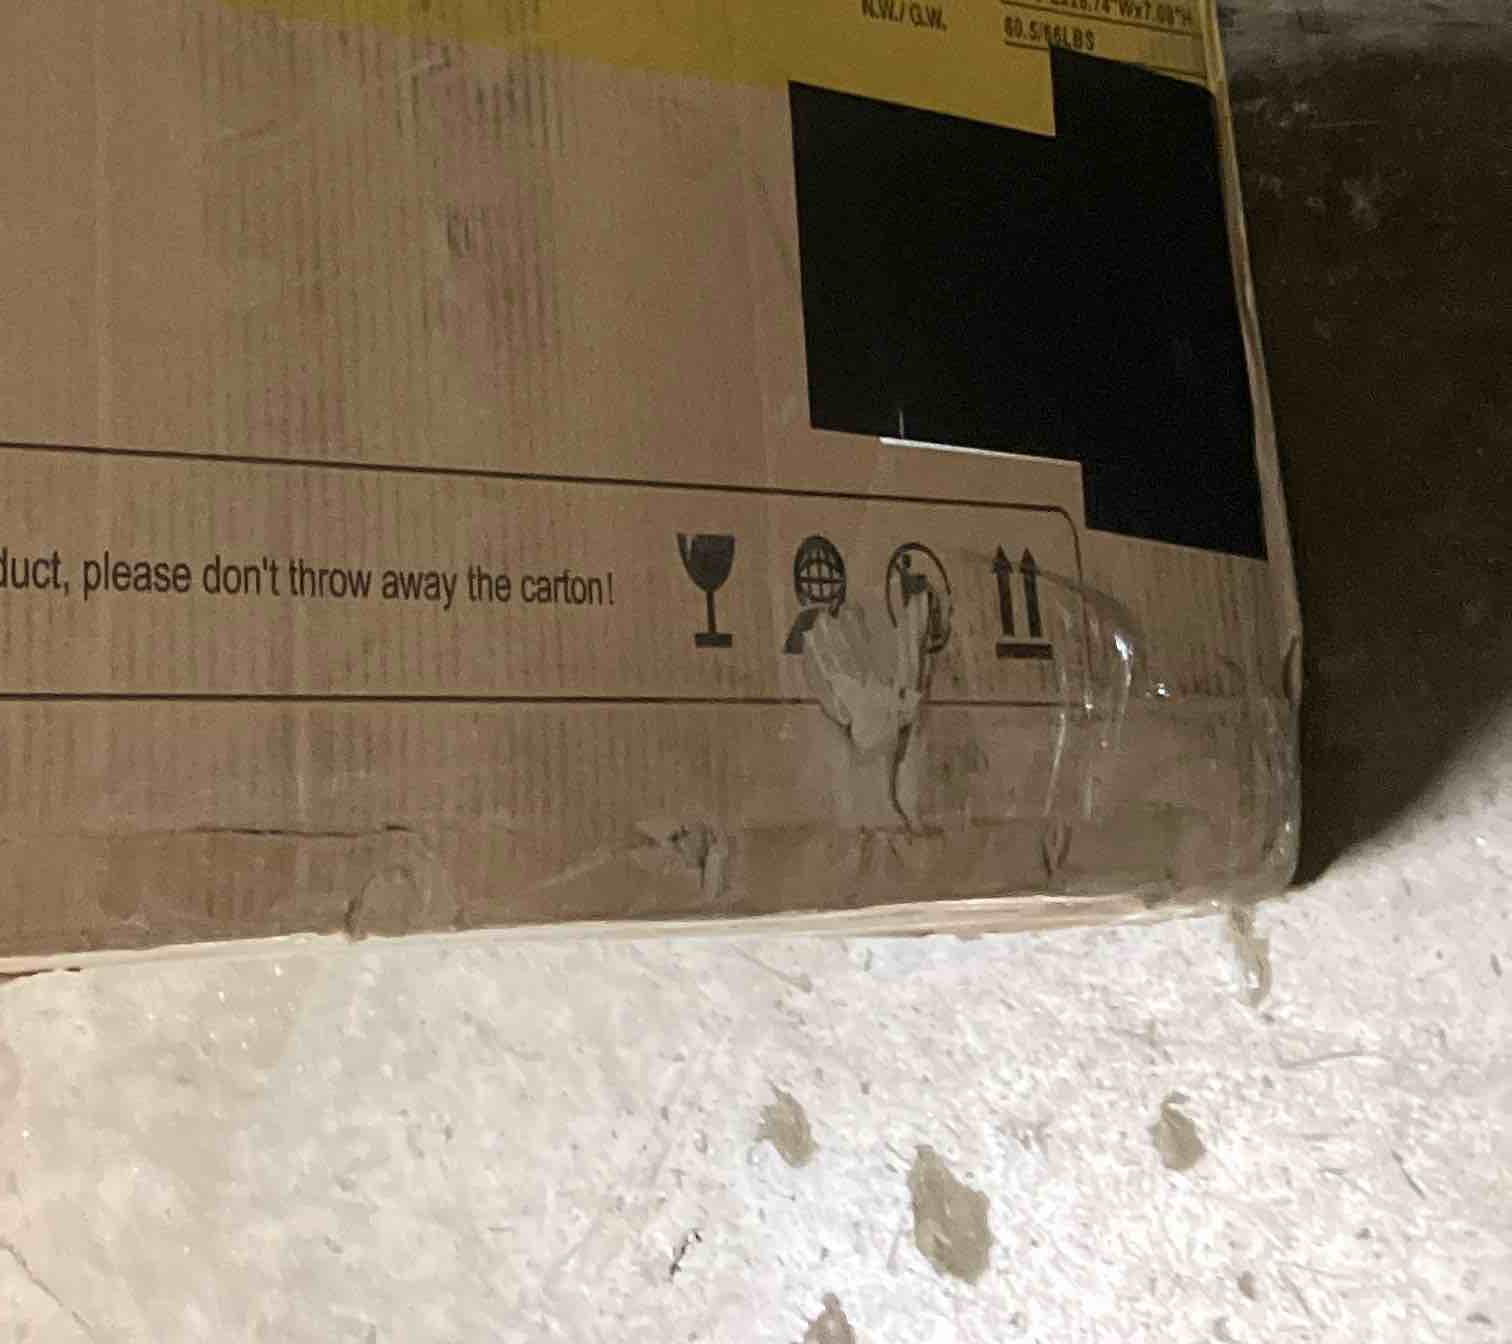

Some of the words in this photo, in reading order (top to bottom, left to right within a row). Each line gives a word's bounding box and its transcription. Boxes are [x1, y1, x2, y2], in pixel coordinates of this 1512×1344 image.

[82, 551, 192, 601] please
[202, 555, 280, 598] don't
[288, 556, 372, 600] throw
[381, 567, 456, 610] away
[467, 564, 512, 605] the
[520, 567, 617, 608] carton!
